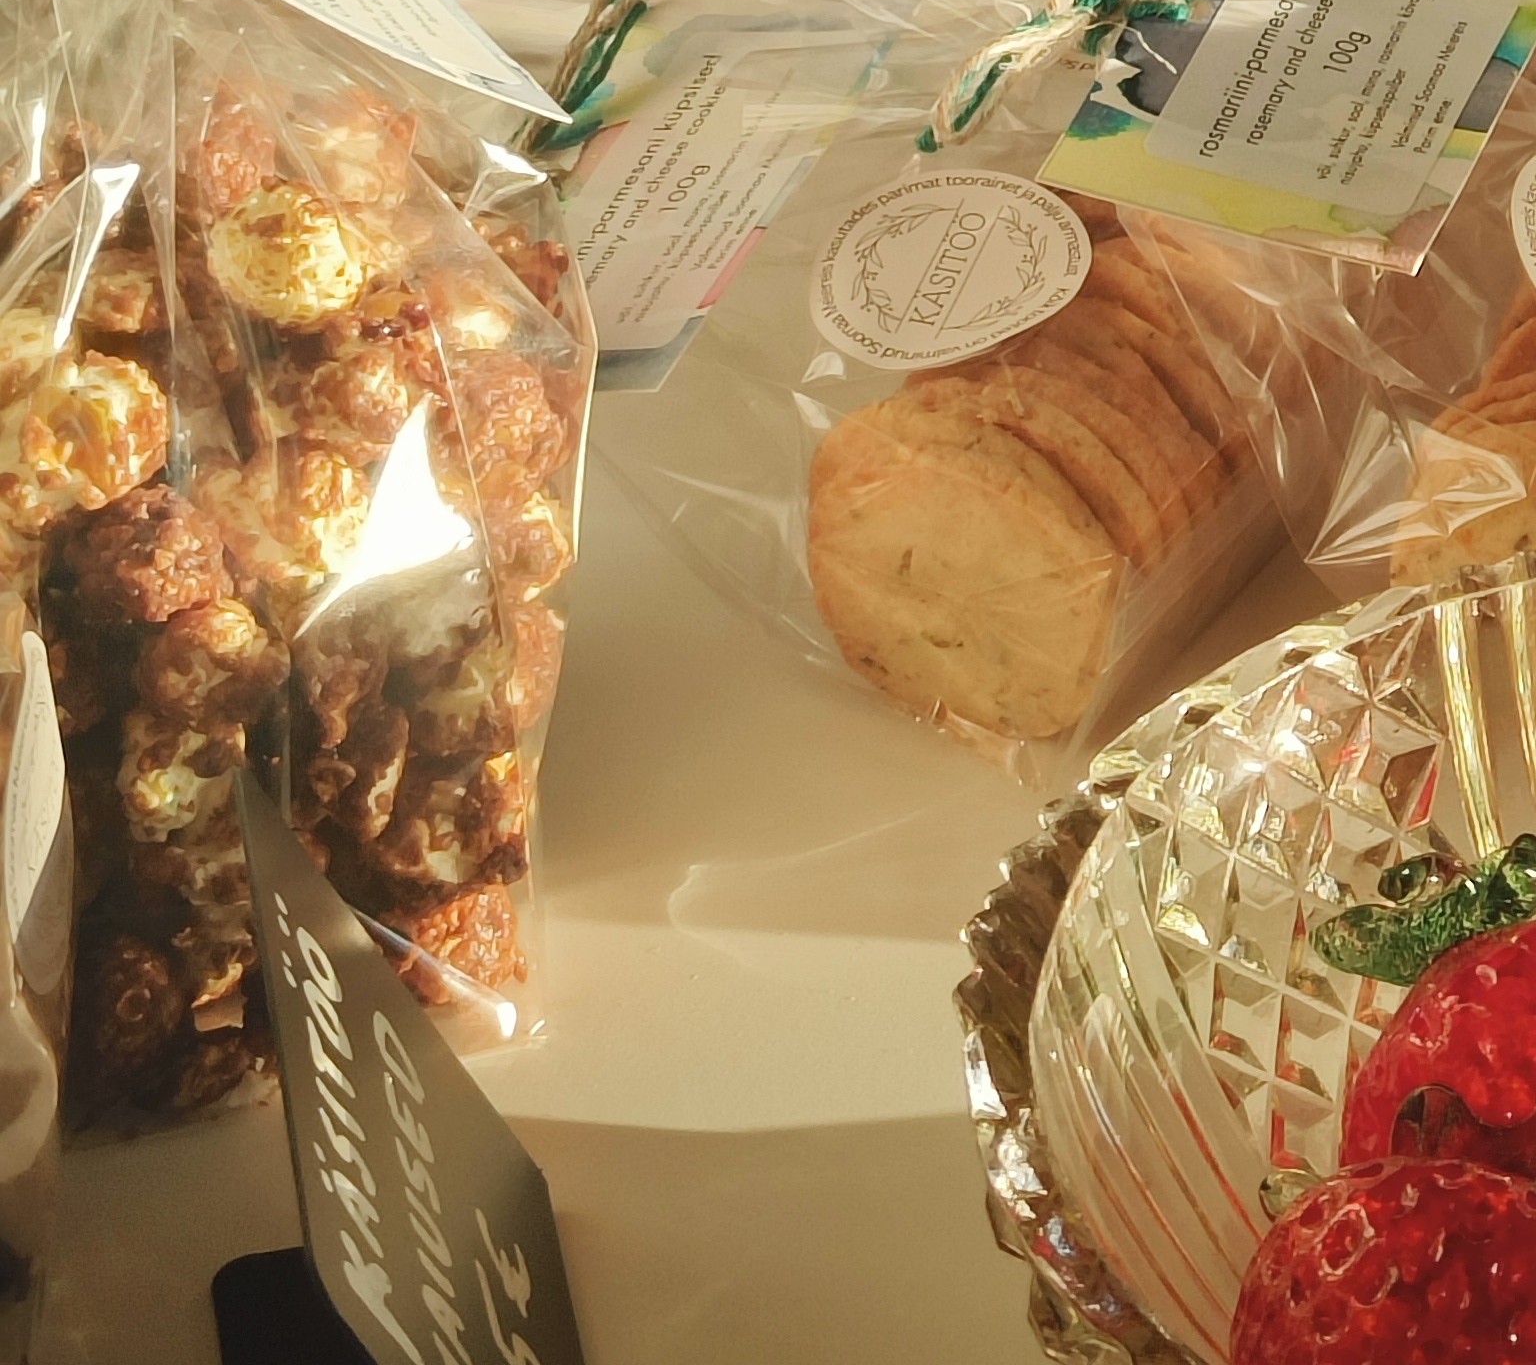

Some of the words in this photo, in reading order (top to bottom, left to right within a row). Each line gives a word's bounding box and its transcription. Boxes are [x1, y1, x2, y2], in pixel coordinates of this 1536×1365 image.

[1323, 30, 1372, 73] 100g
[1246, 77, 1296, 146] rosemary
[1283, 45, 1307, 77] and
[623, 199, 650, 229] and
[686, 83, 727, 137] cookie
[658, 165, 711, 213] 100g
[877, 177, 942, 207] parimat
[945, 175, 1022, 195] toorainet
[1016, 187, 1036, 201] ja
[909, 211, 986, 327] KÄSITÖÖ
